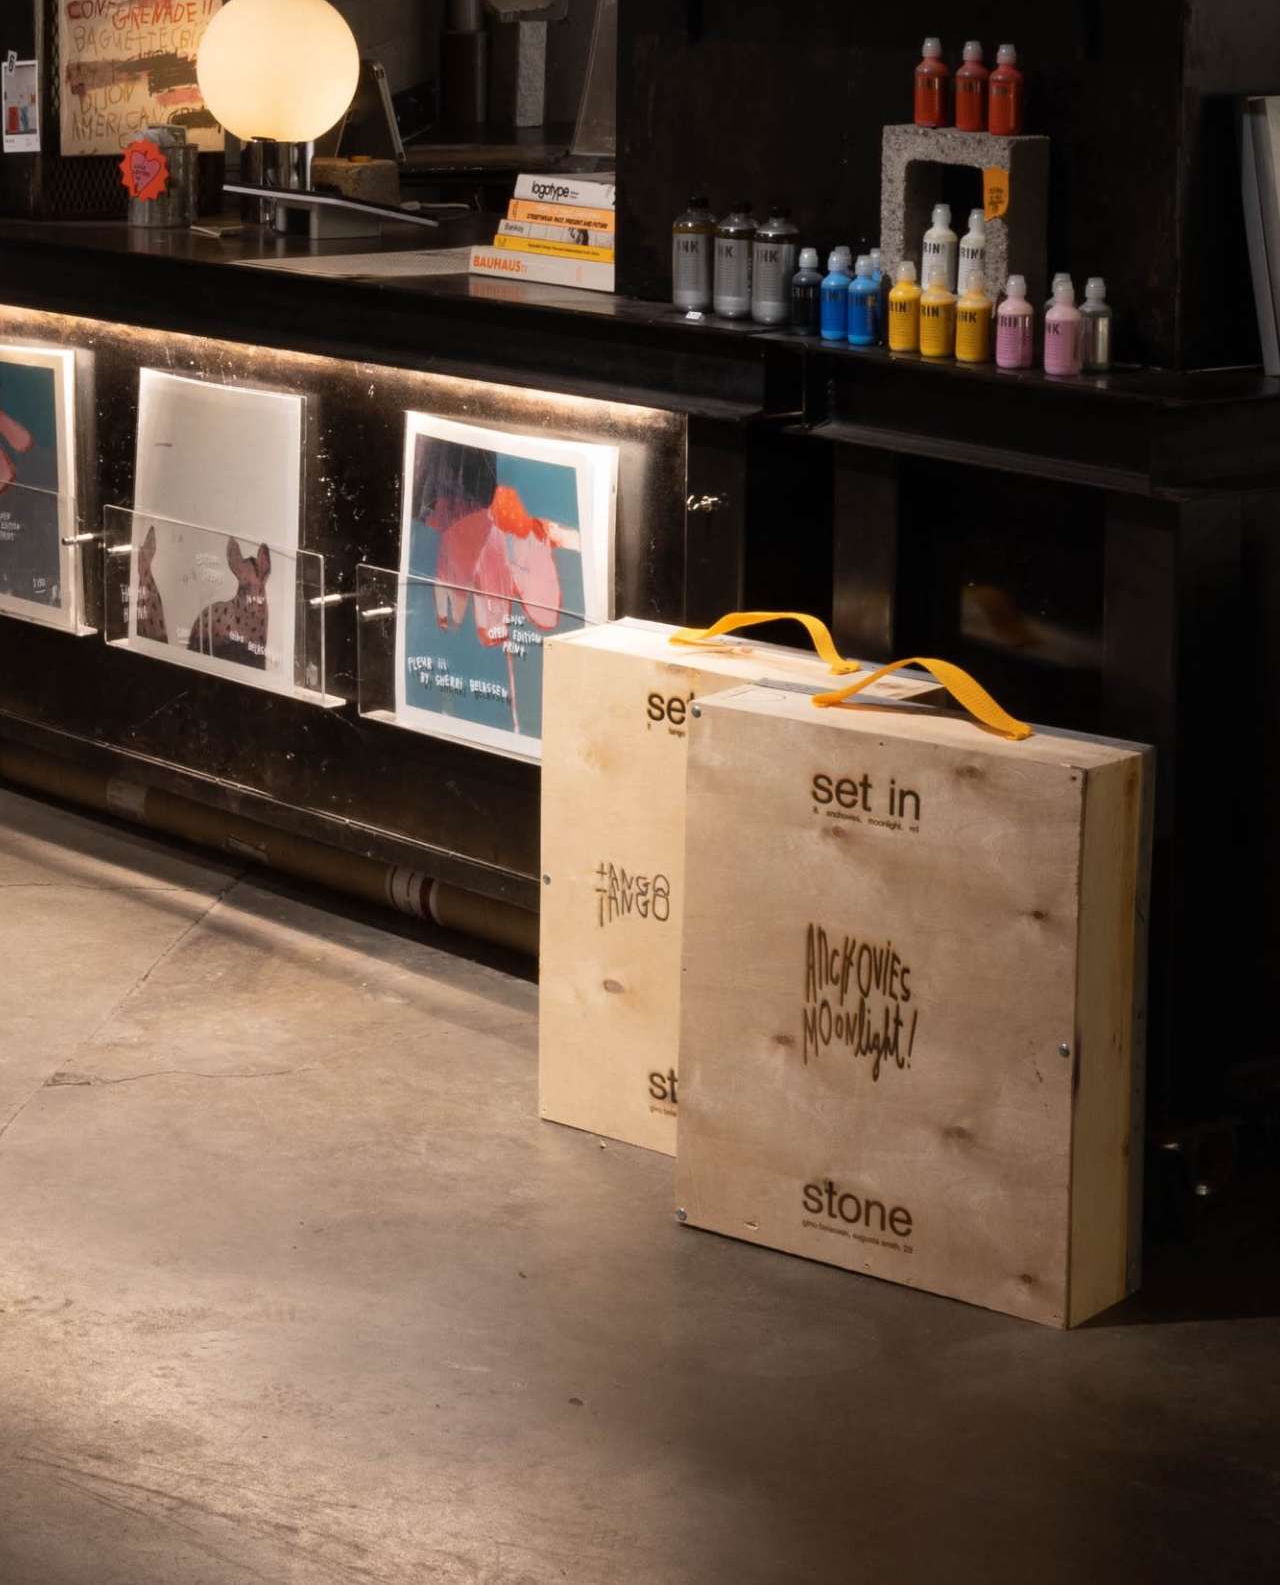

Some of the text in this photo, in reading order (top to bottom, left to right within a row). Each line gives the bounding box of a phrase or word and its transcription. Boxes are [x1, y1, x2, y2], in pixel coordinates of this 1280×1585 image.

[531, 181, 570, 200] logotype
[473, 255, 521, 273] BAUHAUS
[811, 772, 920, 821] set in
[802, 1180, 913, 1237] stone
